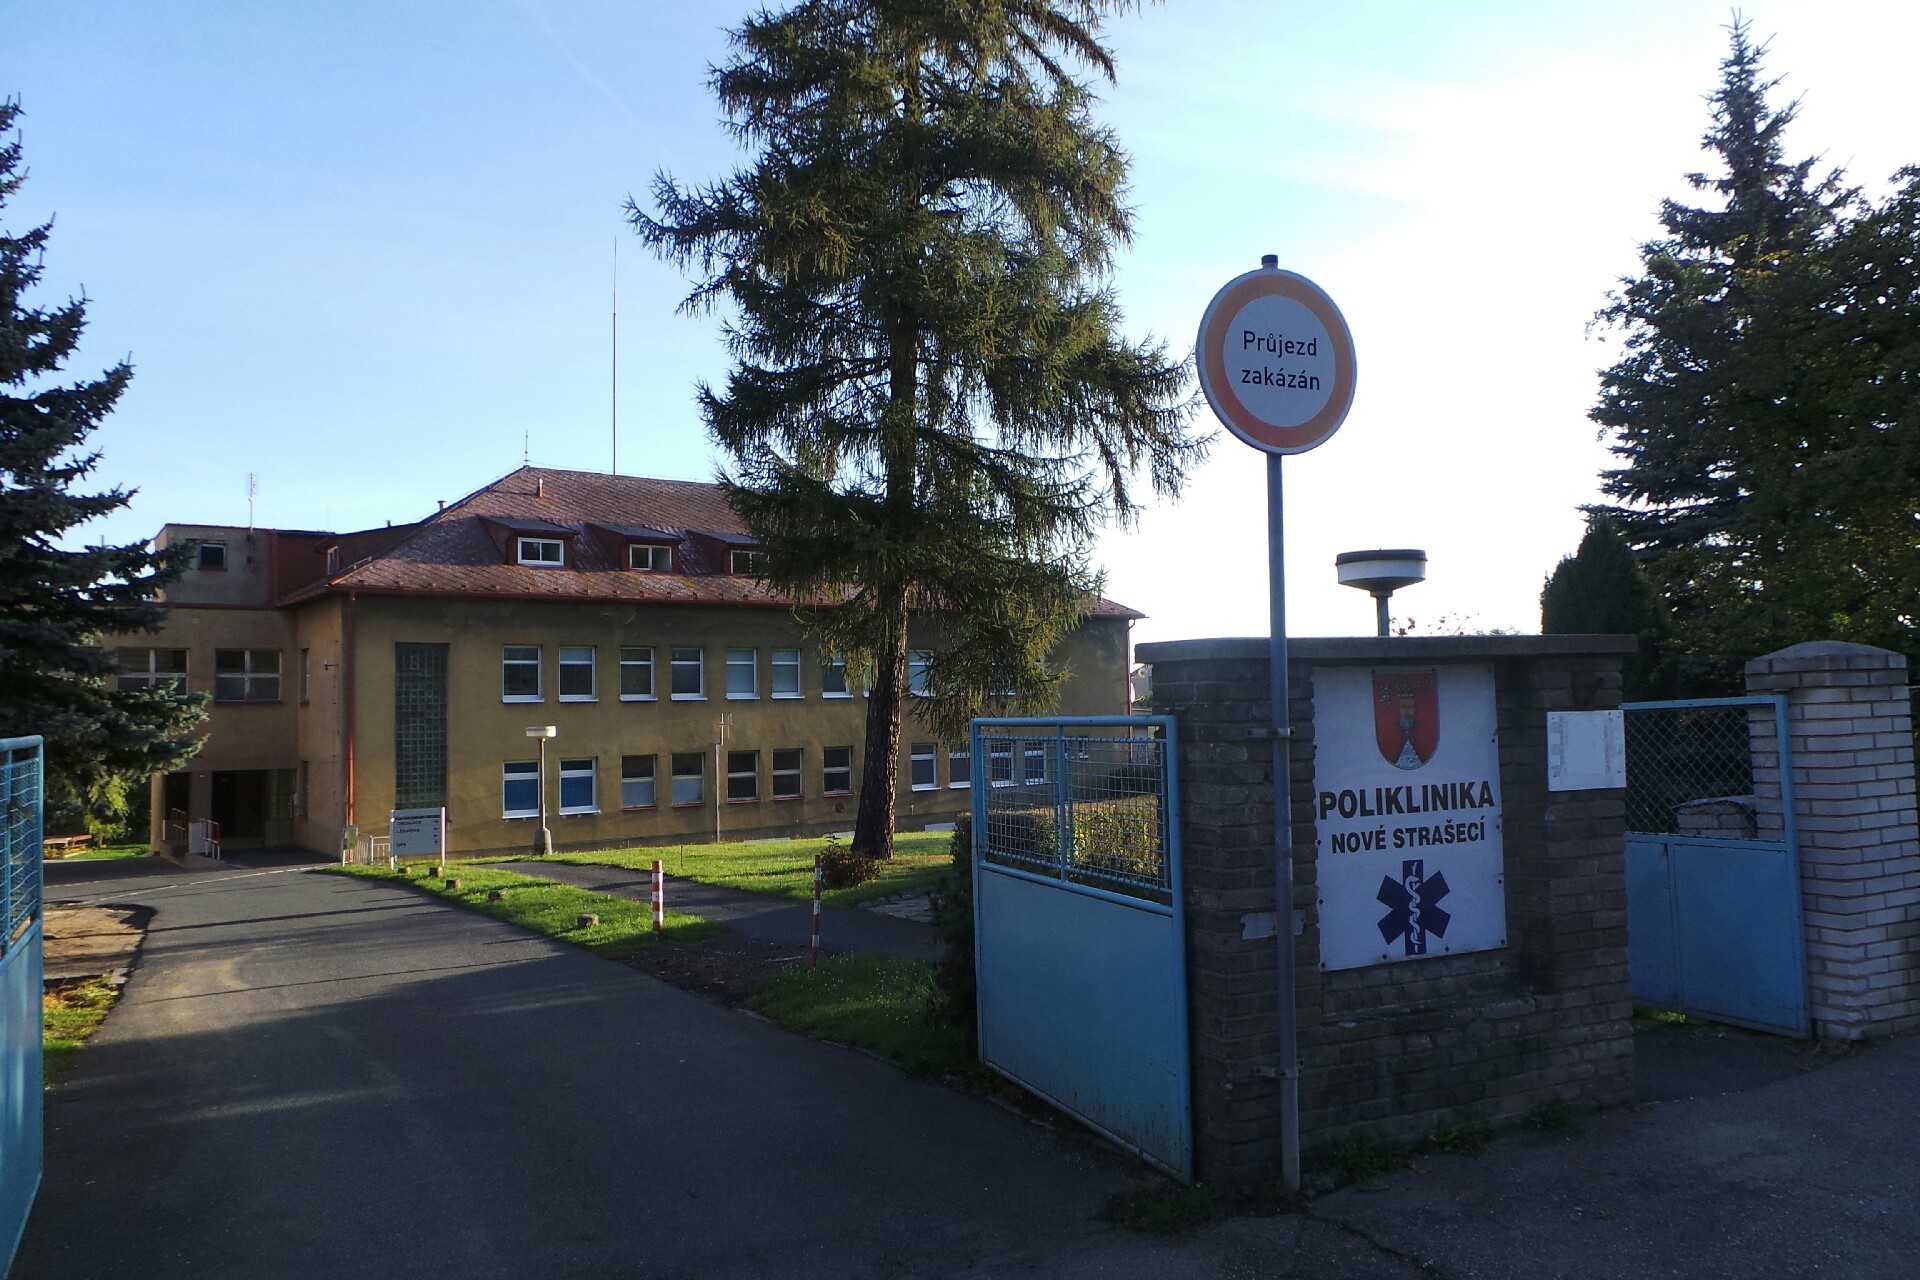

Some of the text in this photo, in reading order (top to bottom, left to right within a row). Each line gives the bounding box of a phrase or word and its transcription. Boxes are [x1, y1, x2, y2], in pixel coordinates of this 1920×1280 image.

[1243, 330, 1317, 358] Průjezd
[1241, 366, 1320, 390] zakázán
[1319, 780, 1495, 820] POLIKLINIKA
[1331, 816, 1486, 854] NOVÉ STRAŠECÍ
